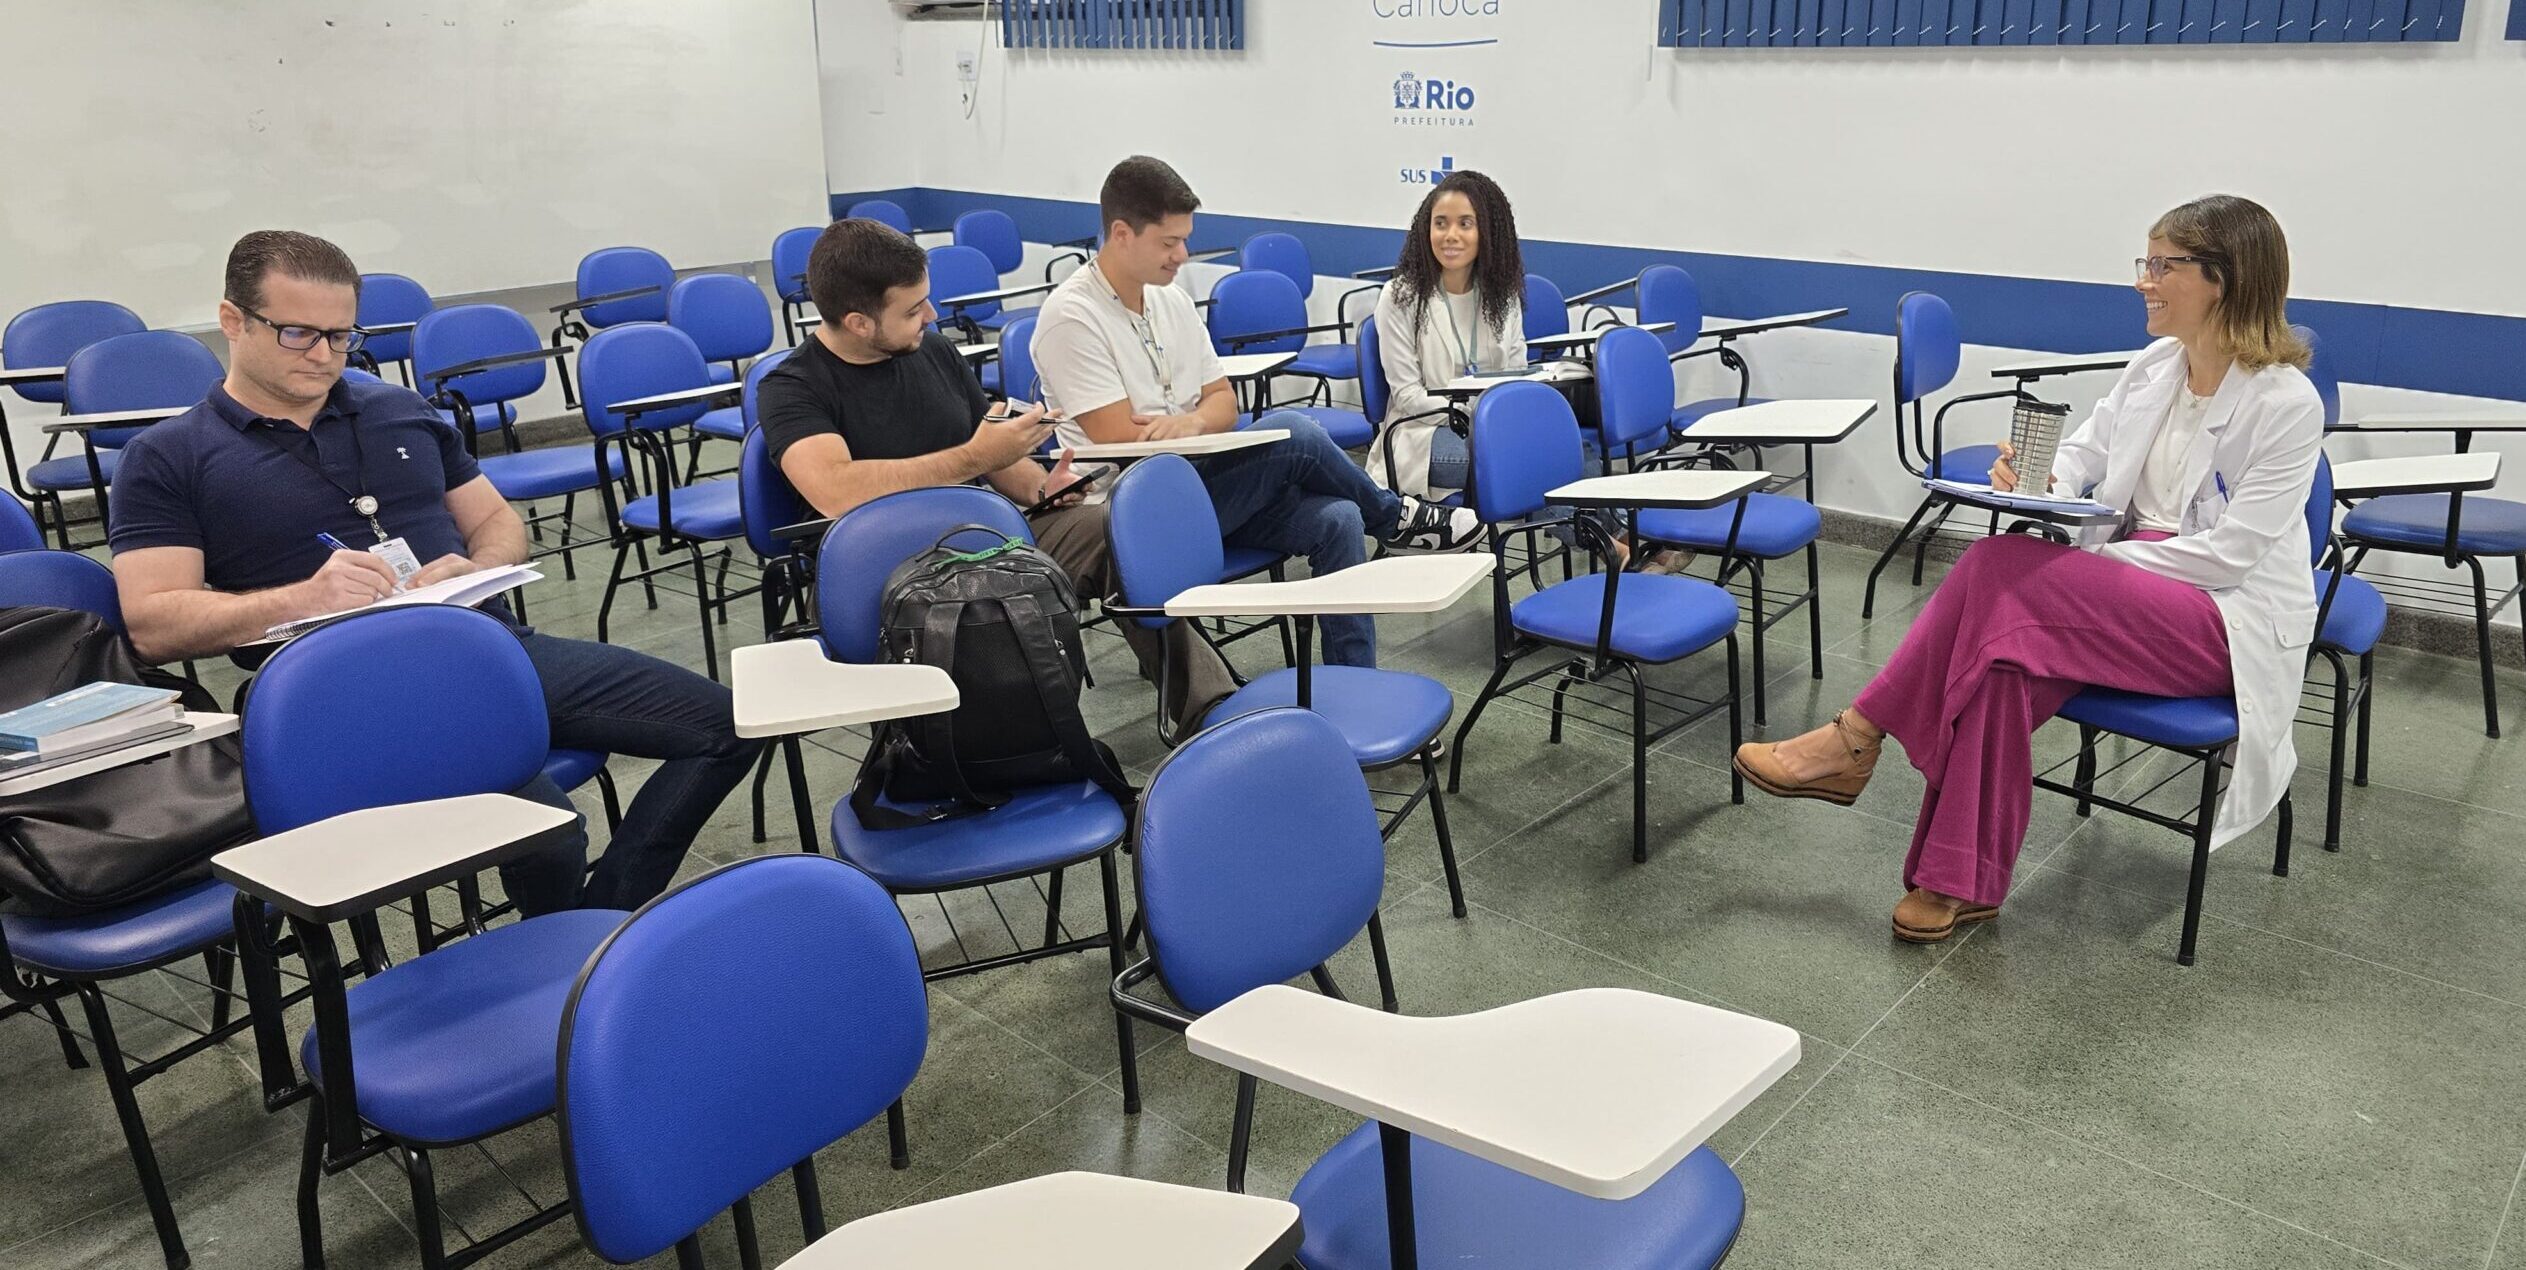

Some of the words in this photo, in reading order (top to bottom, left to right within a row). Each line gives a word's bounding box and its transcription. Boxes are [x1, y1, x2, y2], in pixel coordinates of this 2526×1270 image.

[1426, 80, 1475, 110] Rio
[1394, 117, 1474, 126] PREFEITURA
[1400, 169, 1426, 183] SUS
